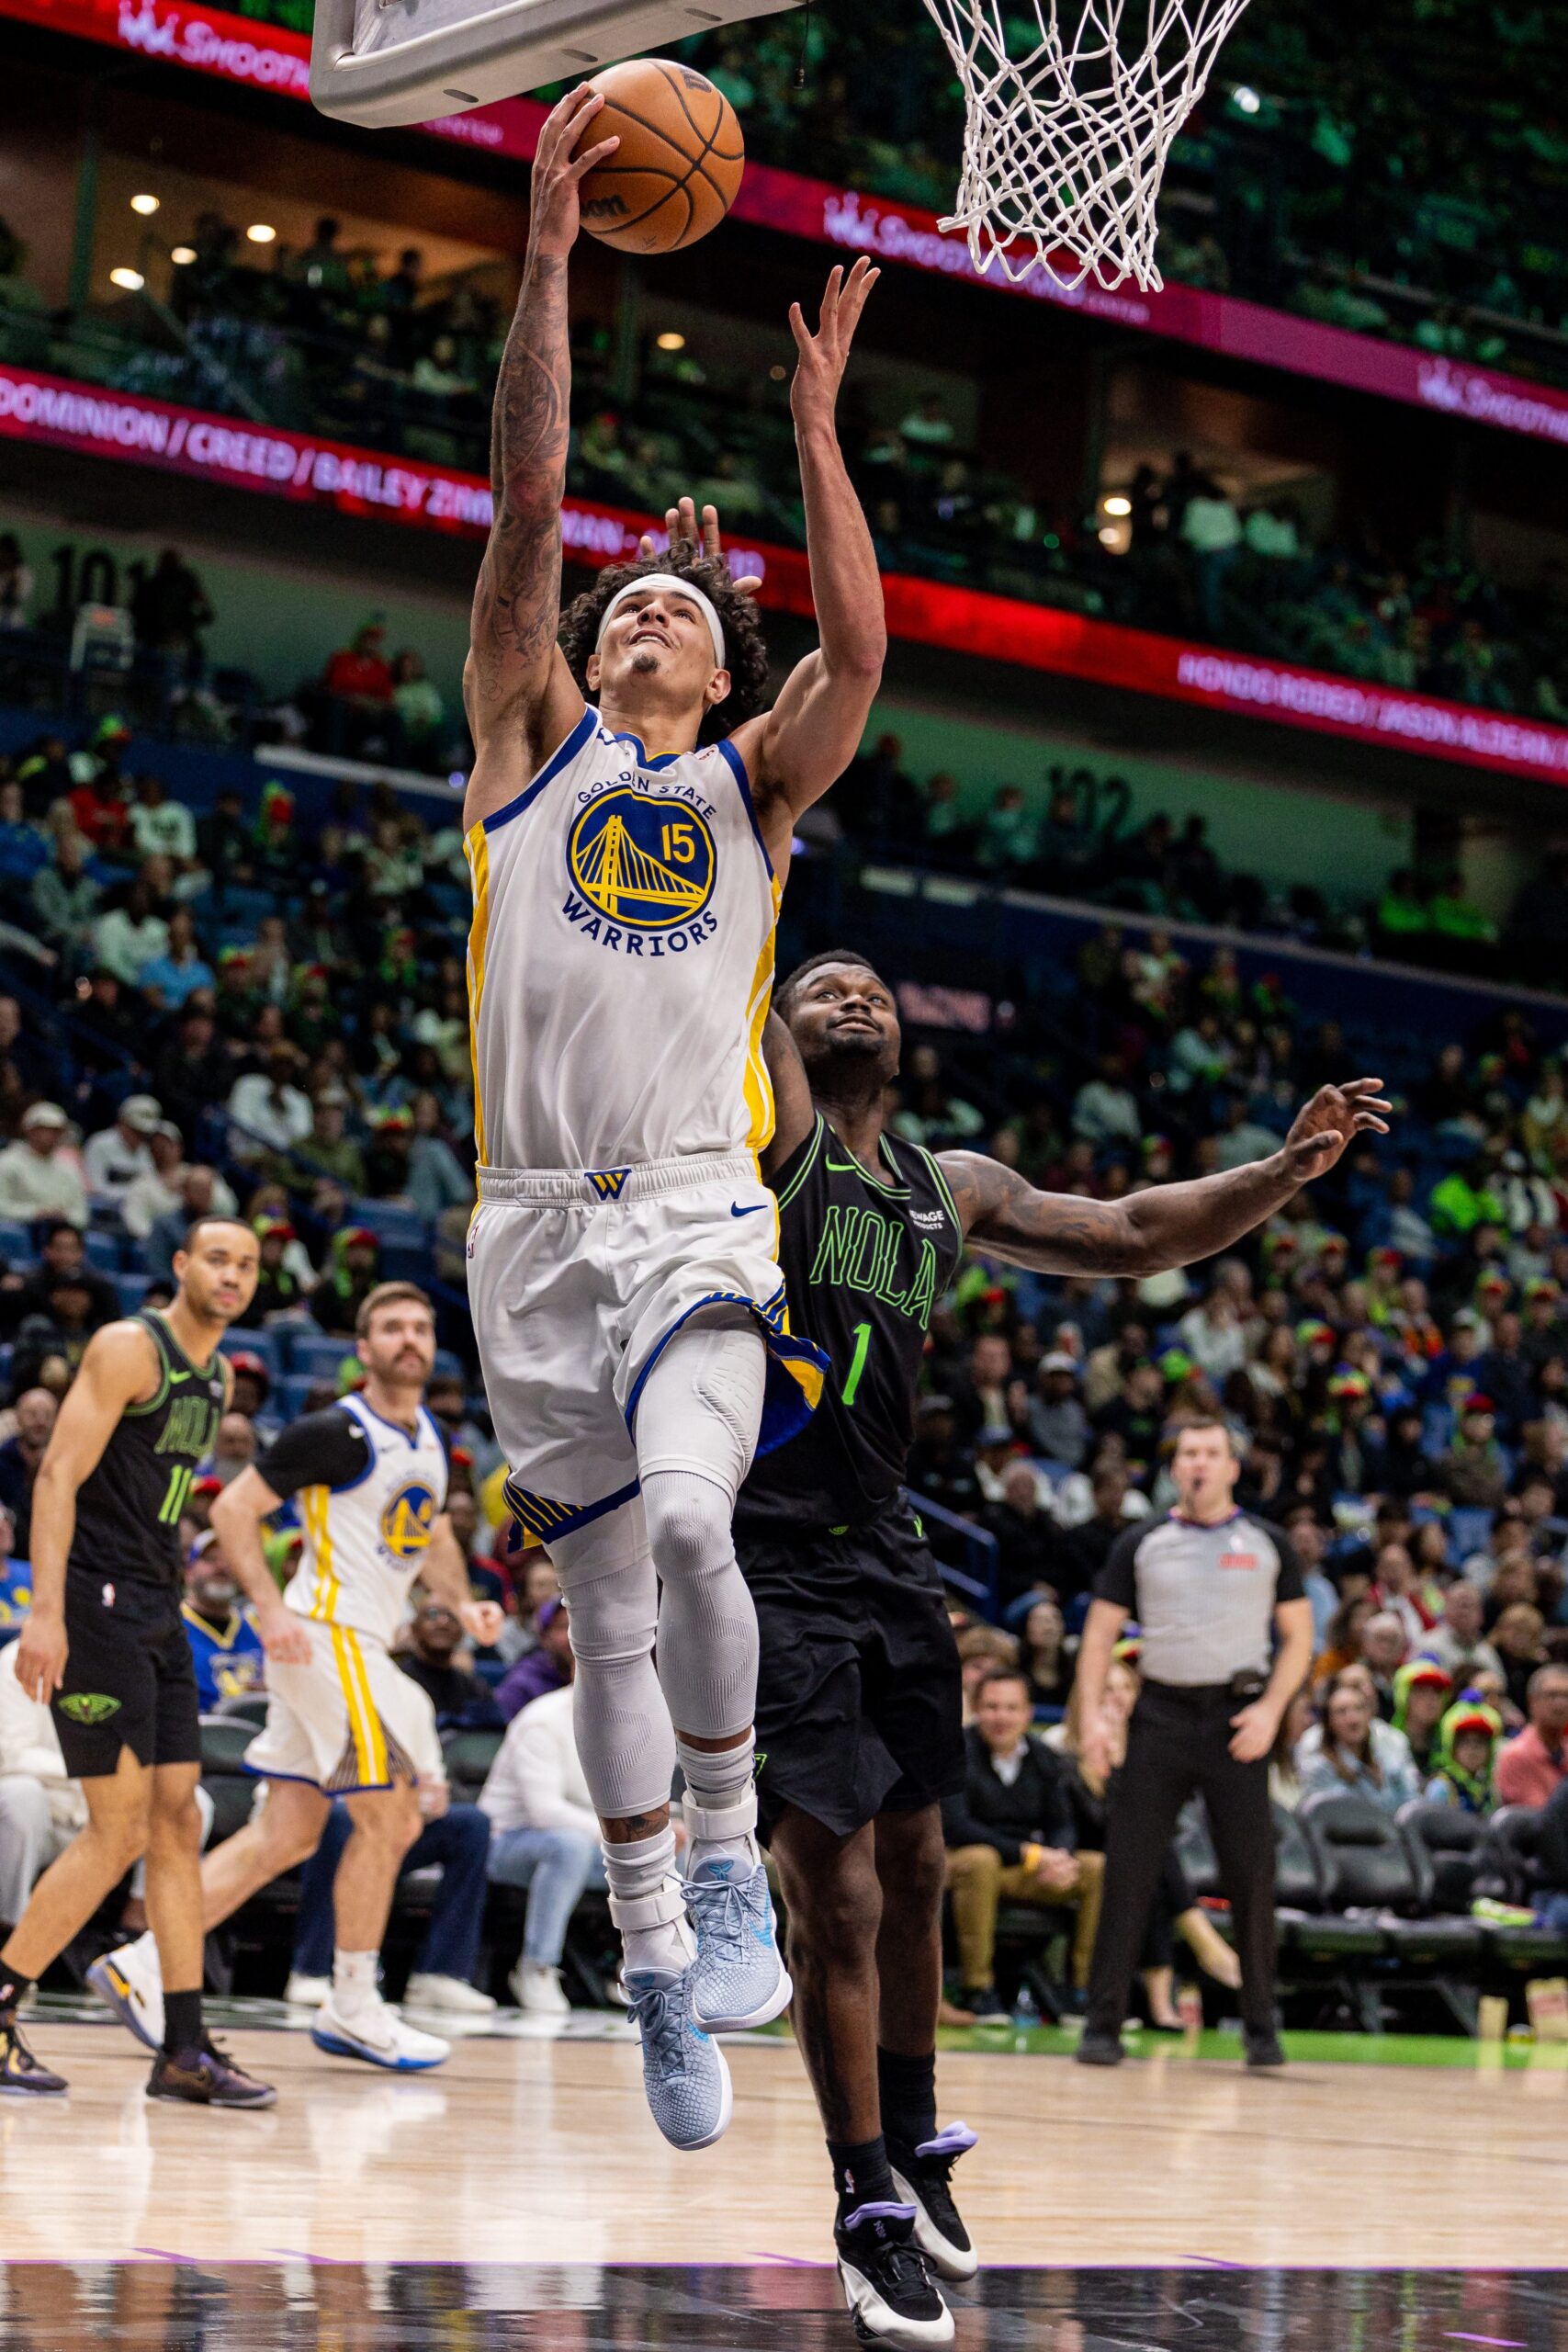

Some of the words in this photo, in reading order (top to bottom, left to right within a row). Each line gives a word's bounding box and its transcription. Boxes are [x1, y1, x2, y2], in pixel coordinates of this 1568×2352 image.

[659, 785, 716, 820] STATE
[661, 823, 695, 863] 15
[562, 890, 717, 956] WARRIORS
[809, 1206, 936, 1331] NOLA
[841, 1322, 872, 1405] 1
[158, 1464, 192, 1525] 11
